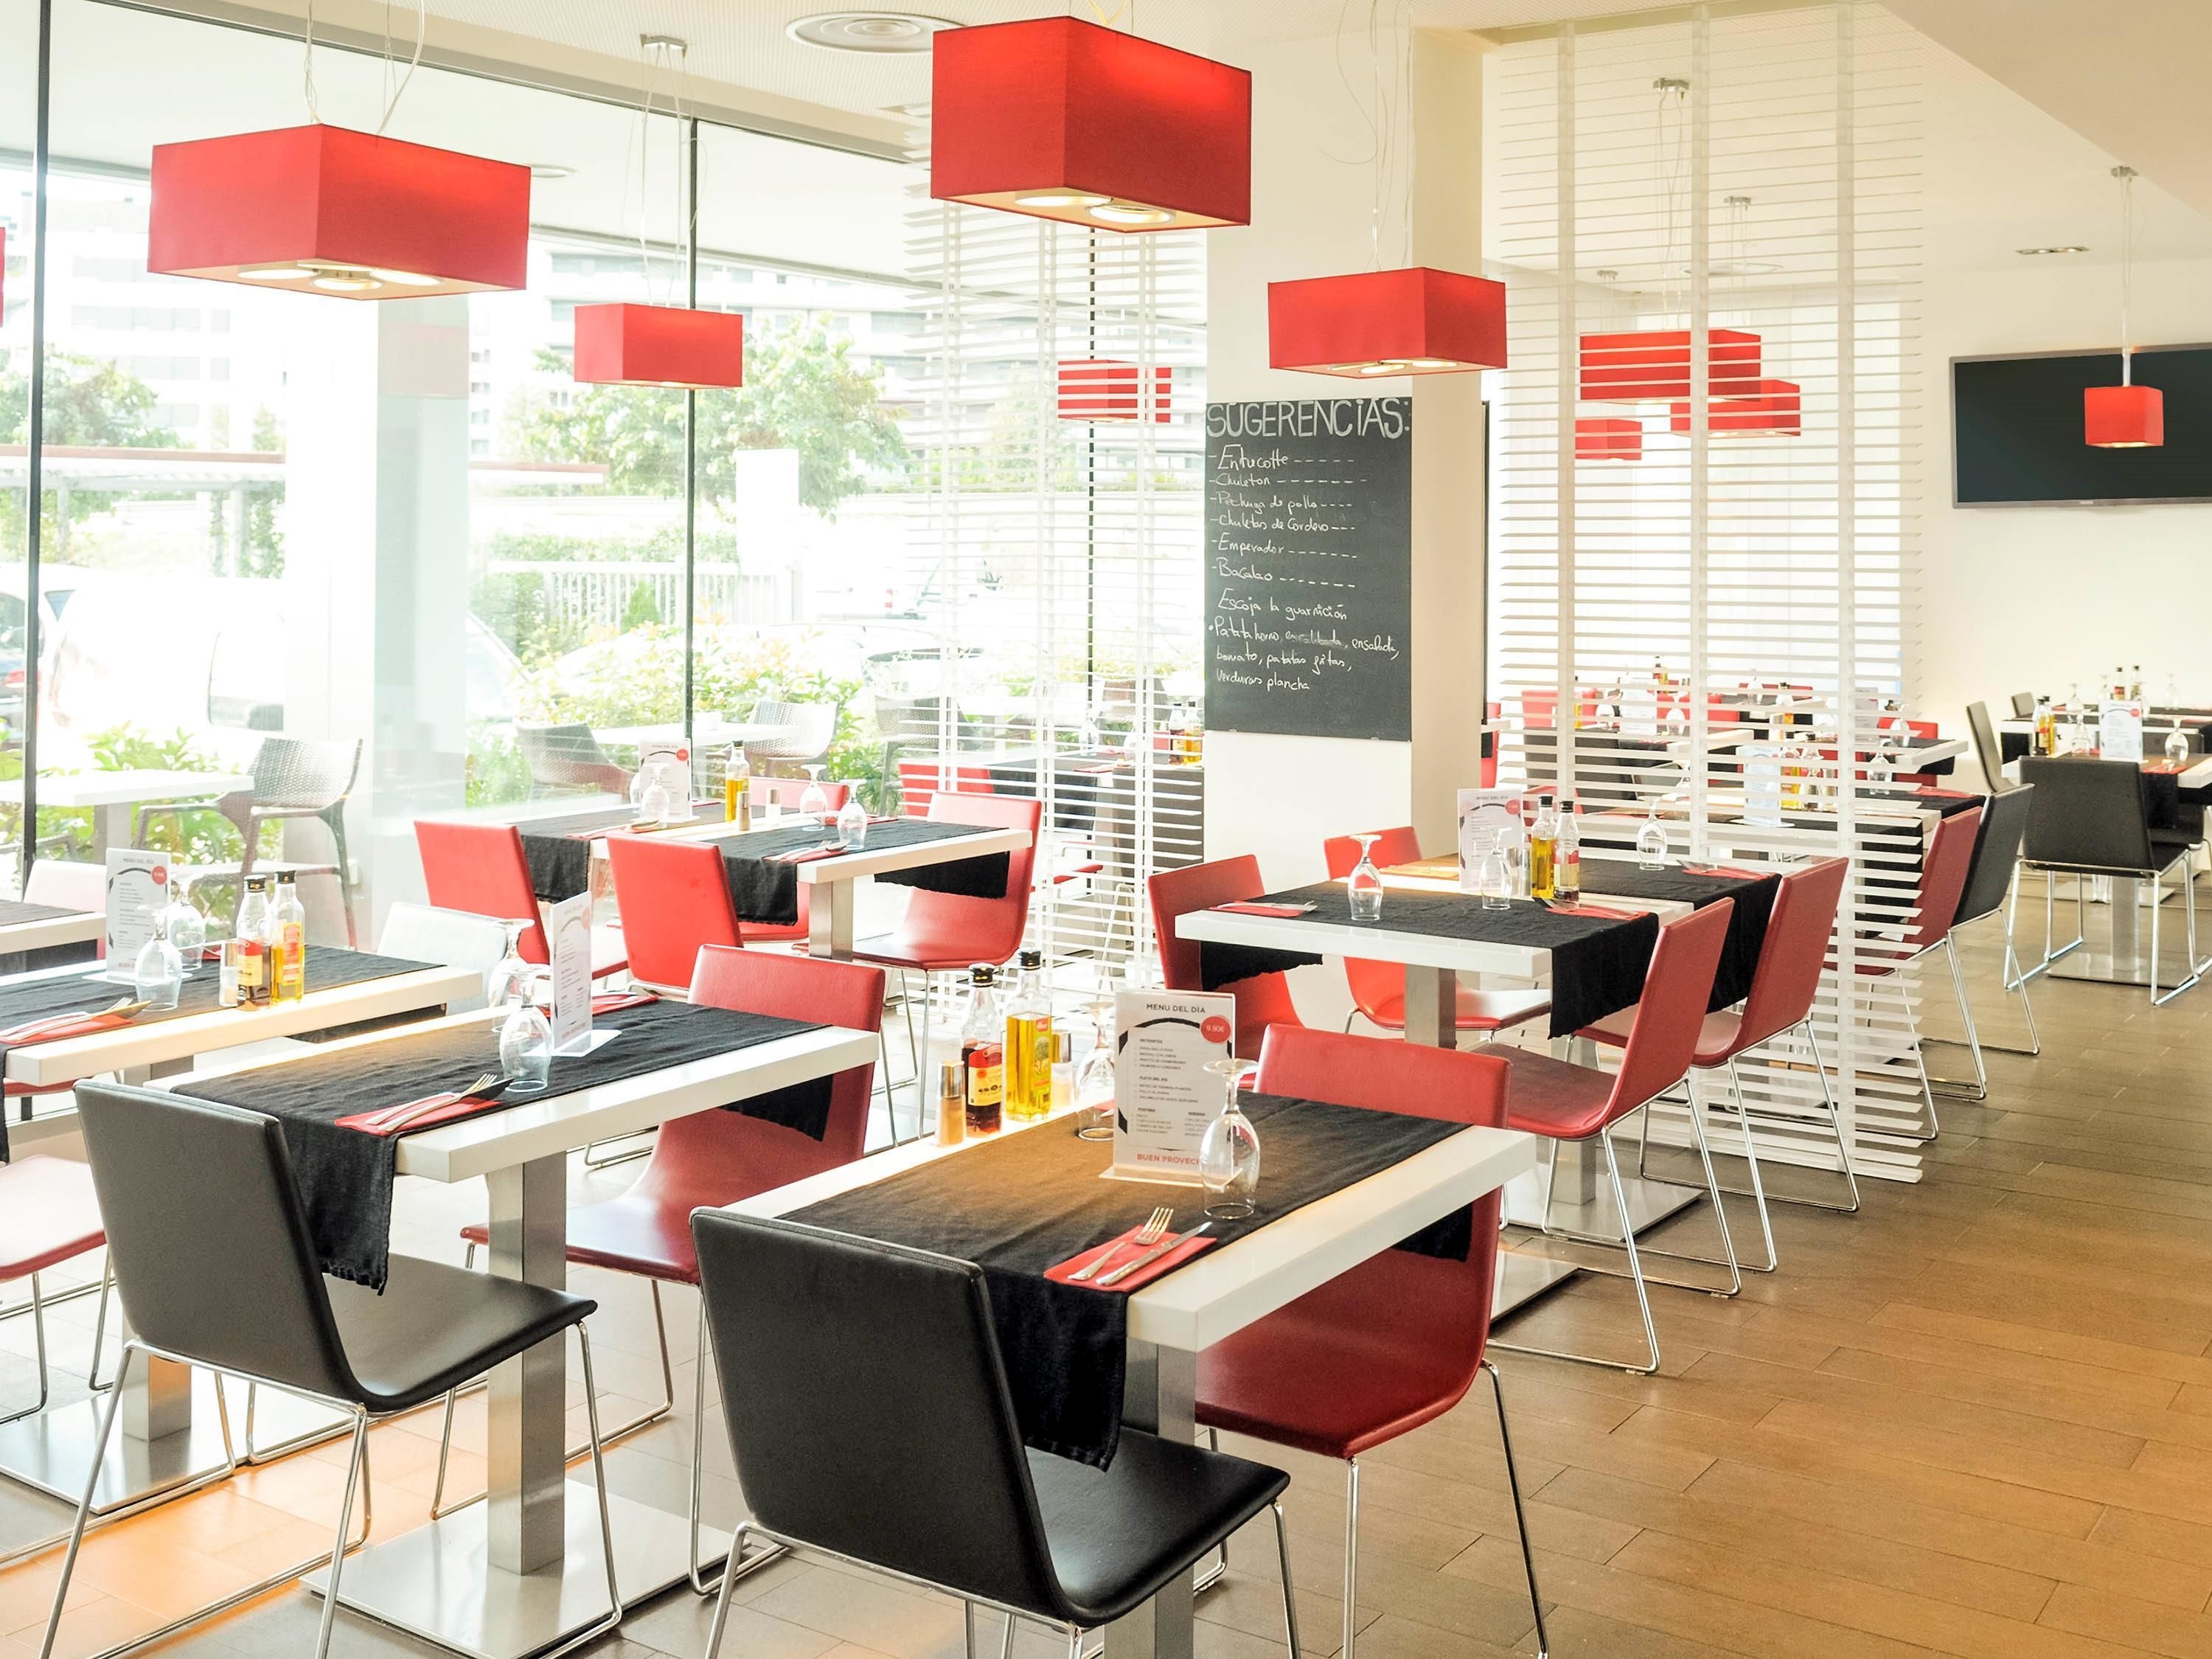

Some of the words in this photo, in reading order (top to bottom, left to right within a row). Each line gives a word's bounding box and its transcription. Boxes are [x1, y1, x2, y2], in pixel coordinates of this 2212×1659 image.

[1287, 495, 1318, 515] pollo
[1271, 518, 1284, 530] de
[1218, 532, 1284, 557] Emperador
[1218, 588, 1262, 616] Escoja
[1270, 597, 1280, 612] la
[1267, 649, 1307, 669] patatas
[1267, 672, 1310, 692] plancha
[1137, 1153, 1160, 1162] BUEN
